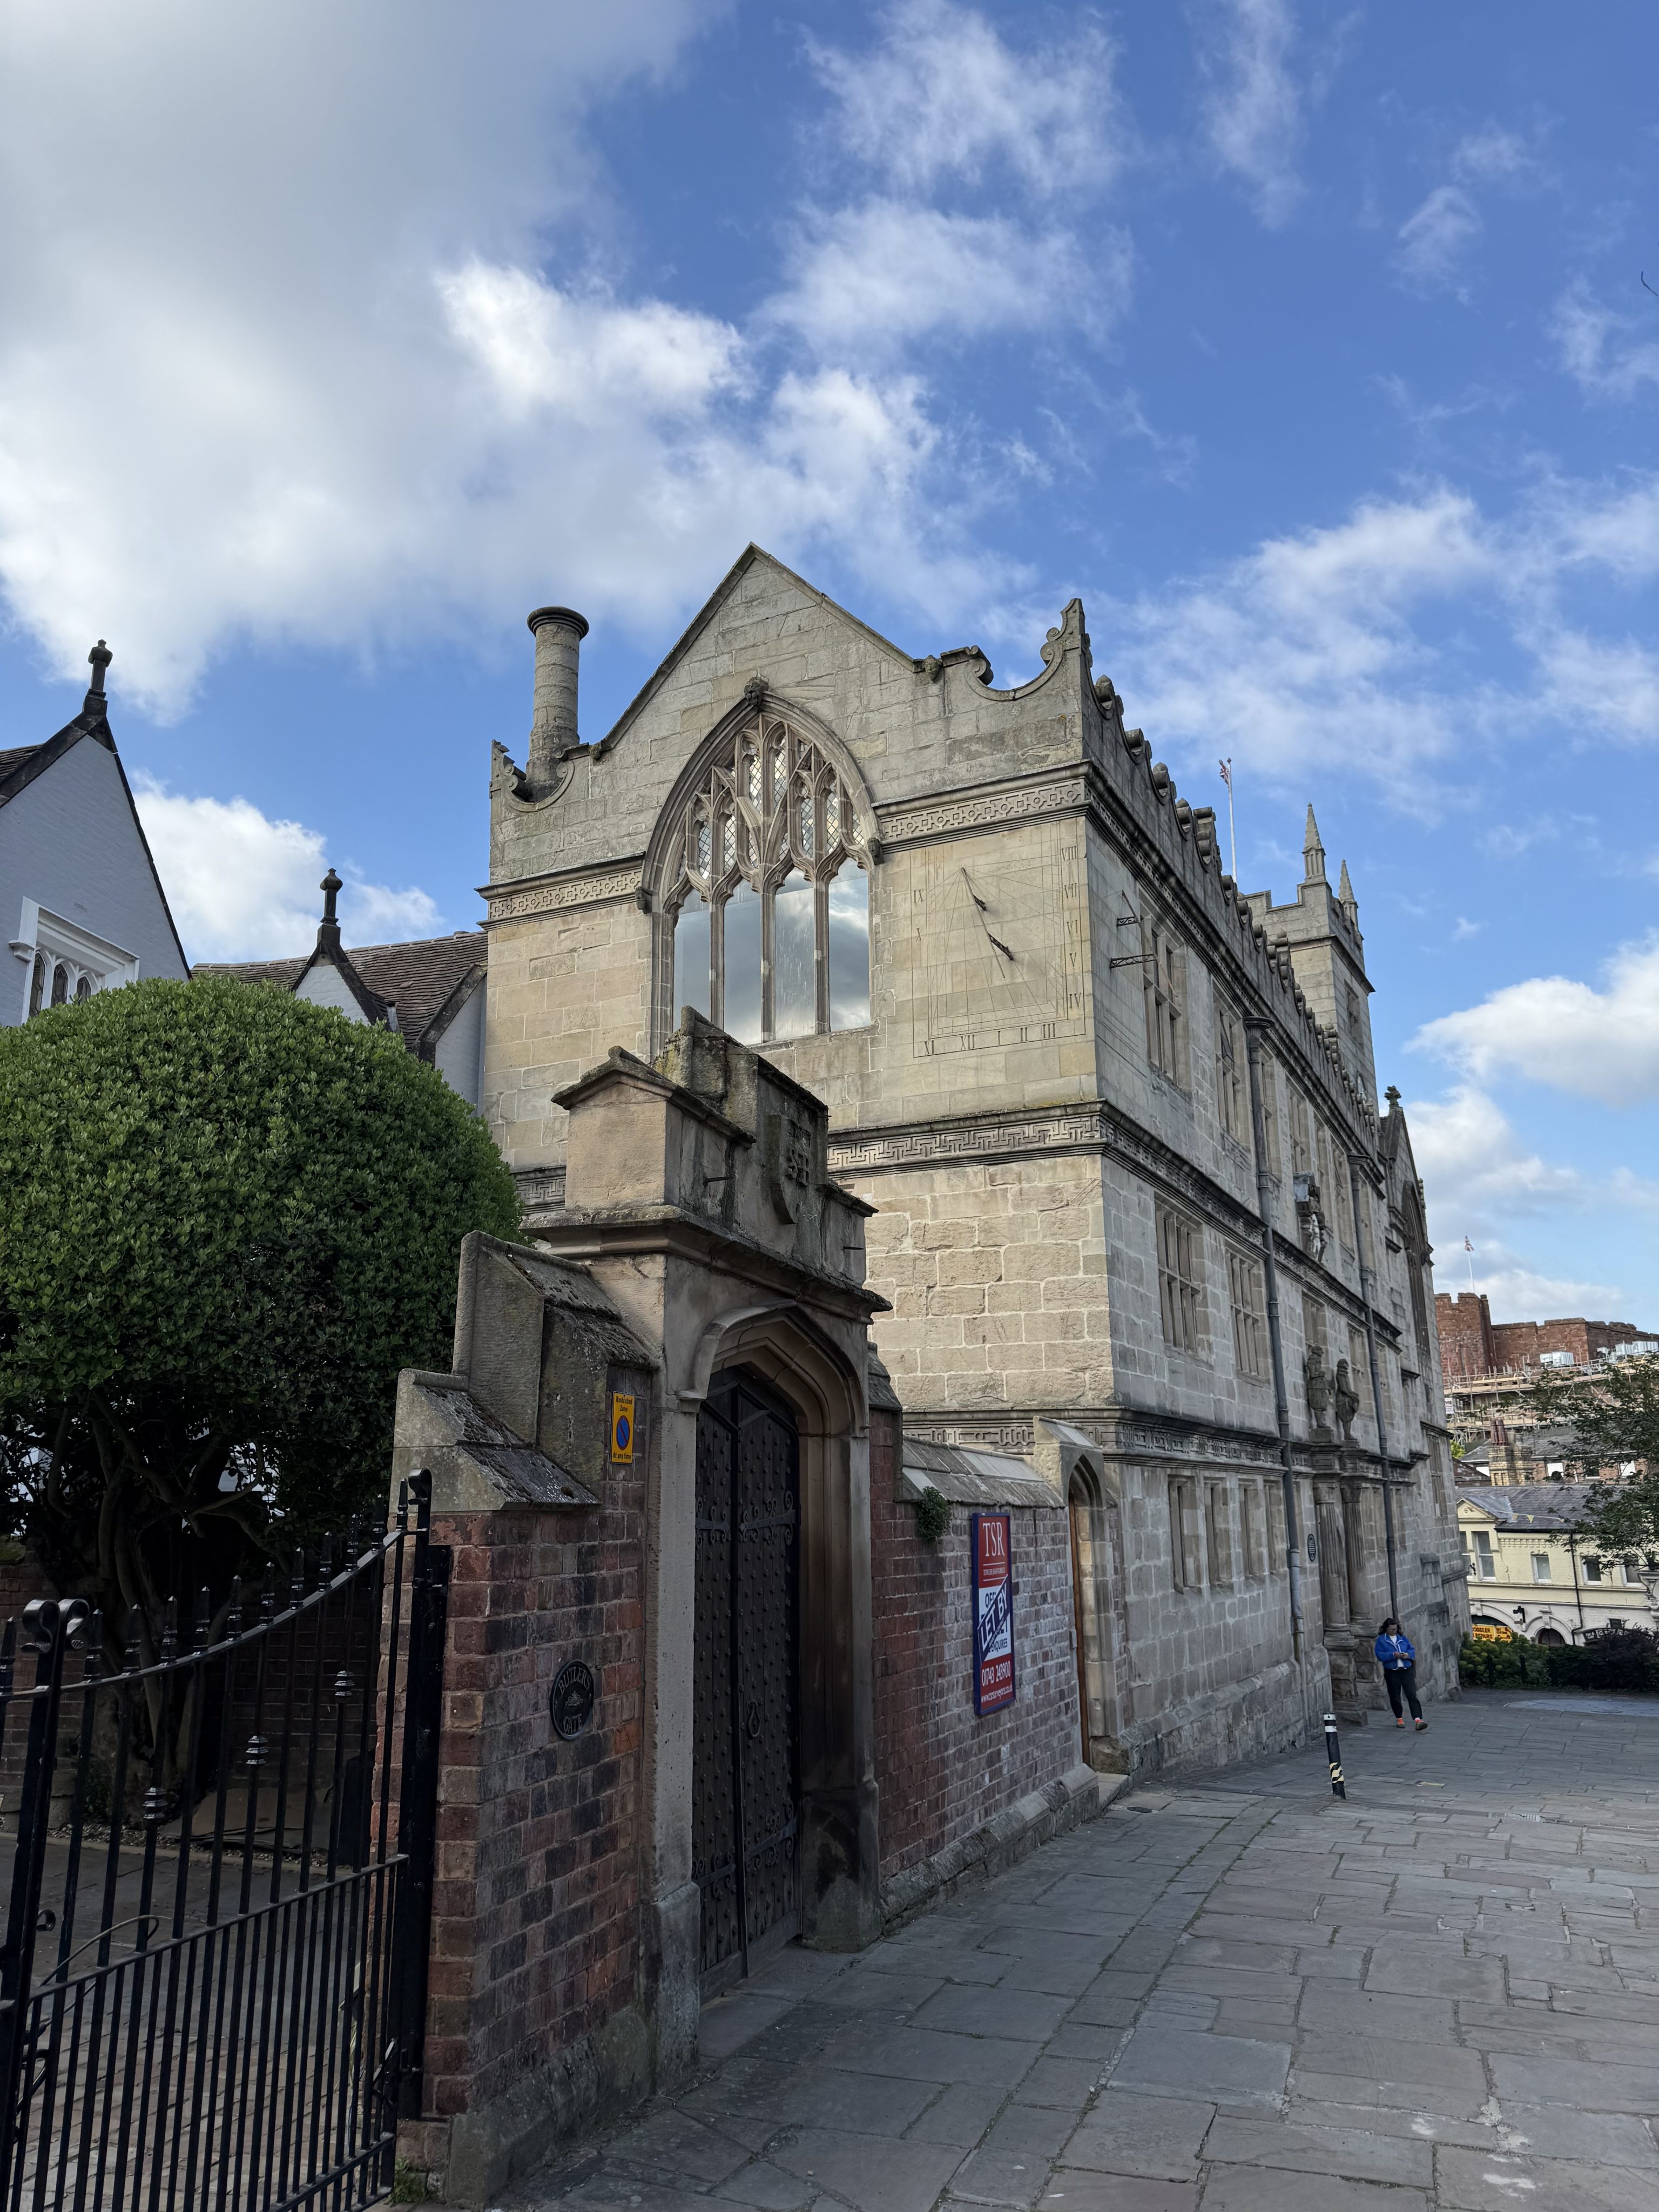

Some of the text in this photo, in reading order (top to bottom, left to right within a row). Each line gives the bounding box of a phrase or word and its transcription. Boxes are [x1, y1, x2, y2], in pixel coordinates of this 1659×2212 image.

[1061, 846, 1077, 861] VIII
[914, 889, 924, 903] IX
[1064, 882, 1077, 899] VII
[915, 928, 923, 942] X
[1067, 920, 1078, 935] VI
[1069, 952, 1077, 968] V
[1069, 992, 1082, 1009] IV
[1020, 1027, 1028, 1042] II
[1042, 1023, 1055, 1039] III
[924, 1040, 934, 1056] XI
[960, 1034, 975, 1050] XII
[616, 1396, 632, 1404] Restricted
[982, 1522, 1005, 1556] TSR
[981, 1603, 996, 1652] LET
[997, 1582, 1007, 1621] BY
[558, 1667, 592, 1695] BUTLERS
[982, 1661, 1011, 1687] 01743 243900
[563, 1714, 582, 1734] GATE
